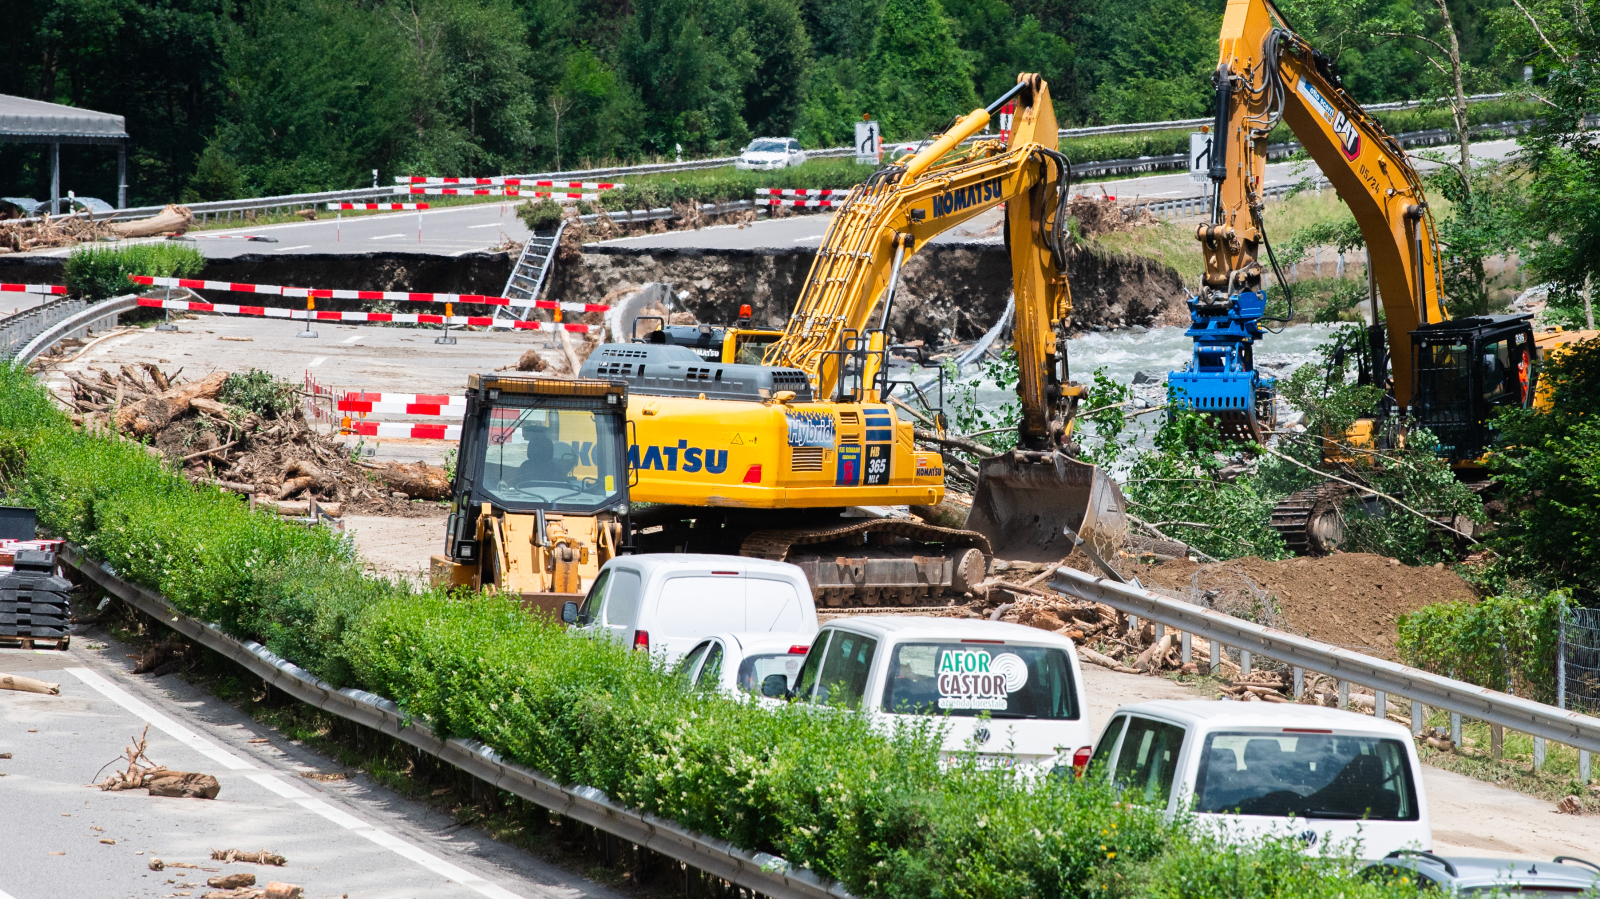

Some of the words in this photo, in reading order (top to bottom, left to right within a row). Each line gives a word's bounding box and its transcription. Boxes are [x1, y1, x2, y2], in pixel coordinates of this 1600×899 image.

[1333, 111, 1359, 151] CAT
[1360, 164, 1380, 194] 05/24
[933, 174, 1003, 218] KOMATSU
[789, 419, 833, 447] Hybrid
[870, 446, 881, 458] HB
[868, 458, 886, 474] 365
[916, 466, 942, 476] KOMATSU
[941, 652, 990, 673] AFOR
[940, 674, 1005, 696] CASTOR
[940, 698, 970, 708] azienda
[972, 699, 1006, 709] forestale
